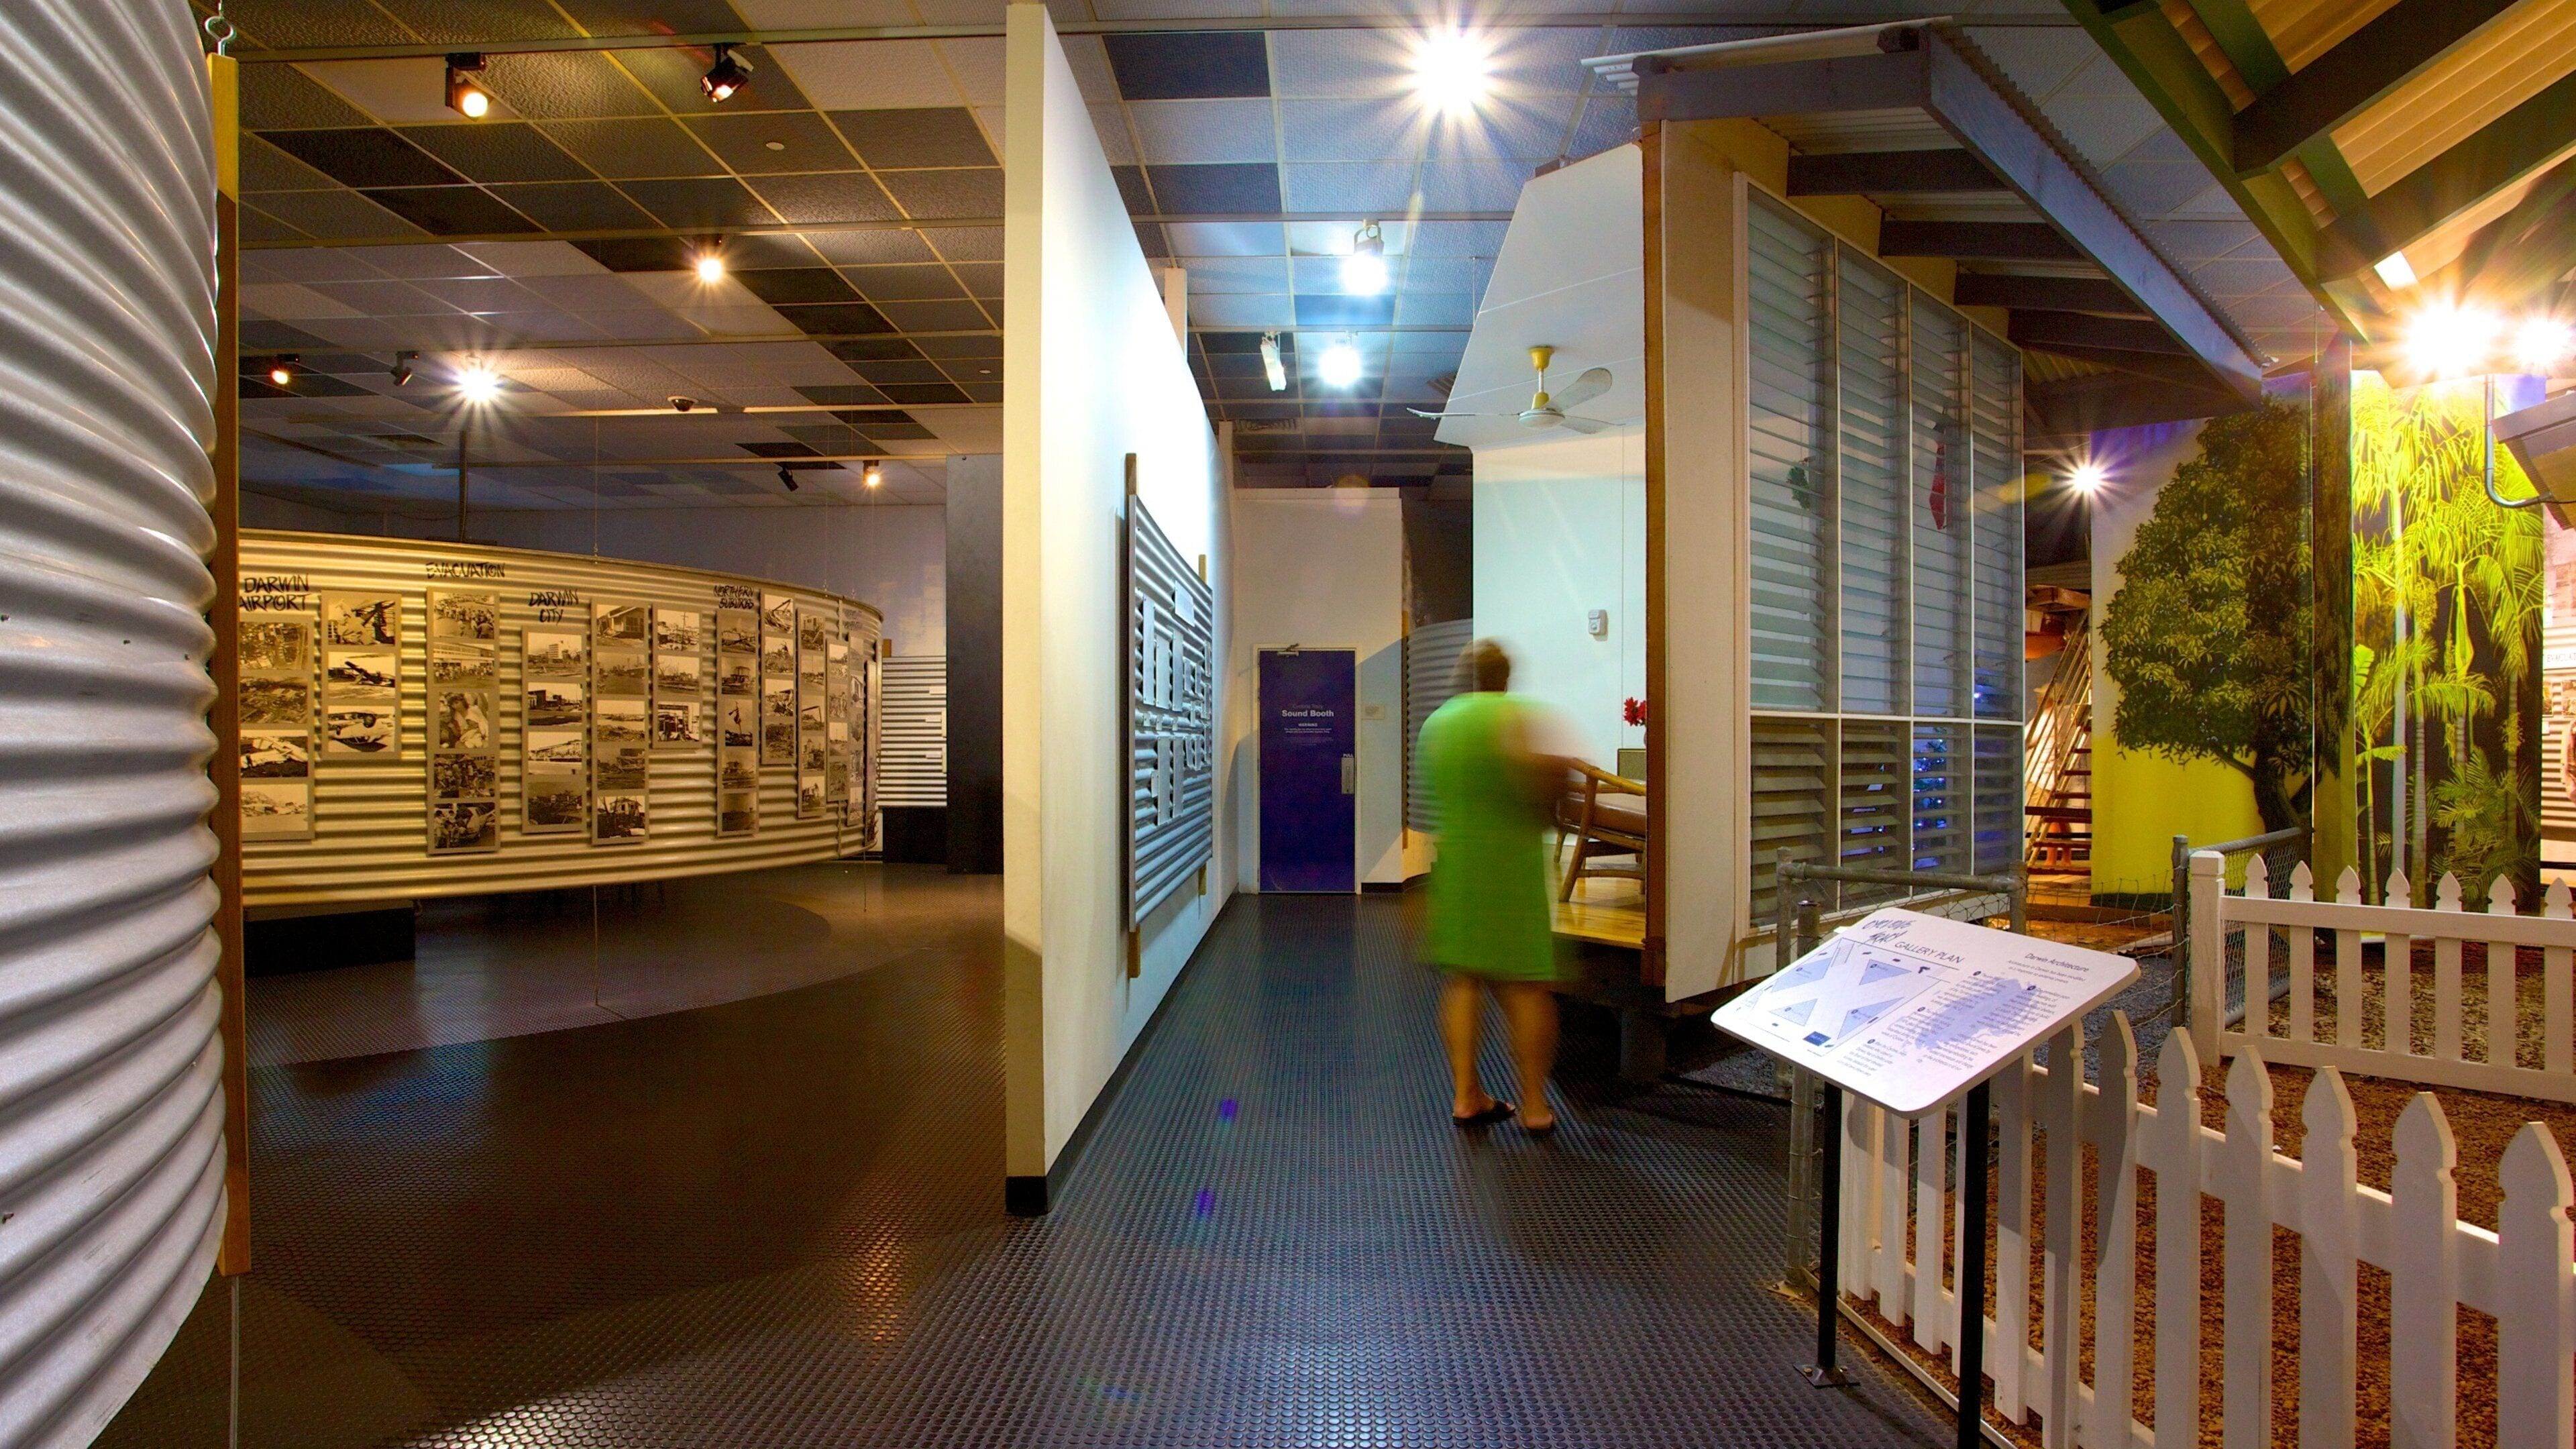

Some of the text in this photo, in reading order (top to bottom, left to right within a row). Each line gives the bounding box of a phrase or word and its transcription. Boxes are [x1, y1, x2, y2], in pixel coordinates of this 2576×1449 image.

[425, 561, 505, 579] EVACUATION
[244, 572, 310, 593] DARWIN
[713, 584, 754, 598] NORTHERN
[239, 593, 311, 612] AIRPORT
[528, 588, 579, 608] DARWIN
[718, 597, 755, 609] SUBURBS
[539, 608, 564, 626] CITY
[1281, 709, 1334, 717] Sound Booth
[1894, 941, 1965, 963] GALLERY PLAN
[2025, 953, 2090, 973] Darwin Architecture
